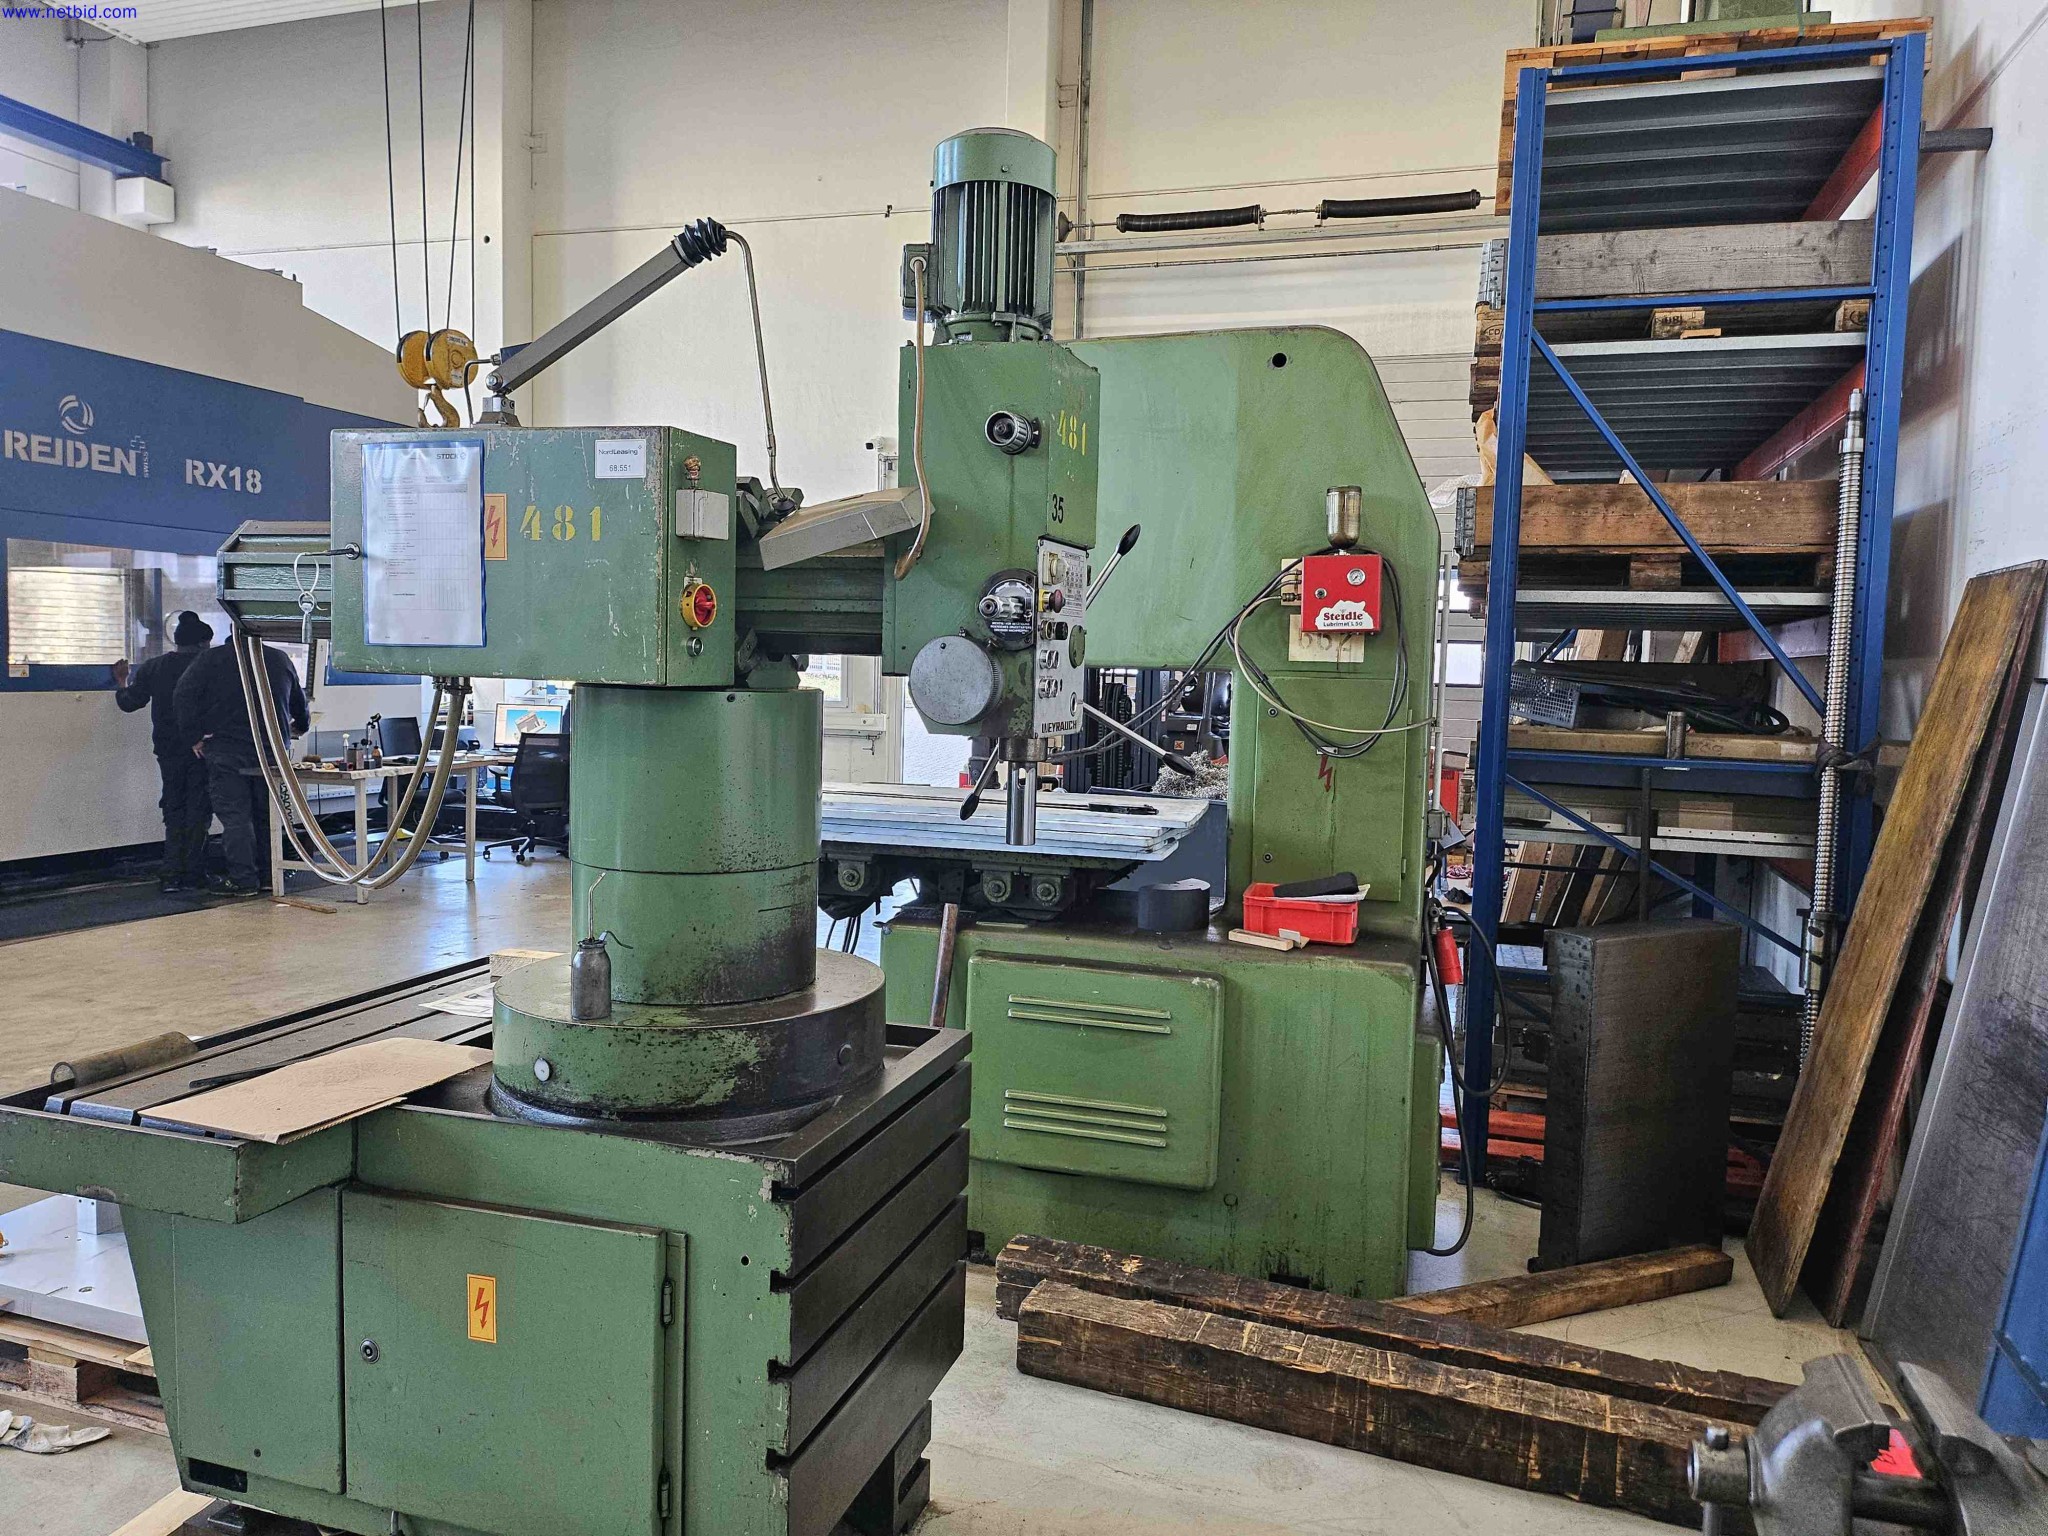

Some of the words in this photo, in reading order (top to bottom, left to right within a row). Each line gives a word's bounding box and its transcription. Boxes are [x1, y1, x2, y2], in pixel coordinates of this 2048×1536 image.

[1057, 409, 1087, 456] 481
[3, 429, 137, 477] REIDEN
[185, 458, 262, 494] RX18
[519, 504, 602, 542] 481
[1051, 493, 1064, 524] 35
[1323, 611, 1364, 621] Steidle
[1041, 719, 1077, 733] WEYRAUCH
